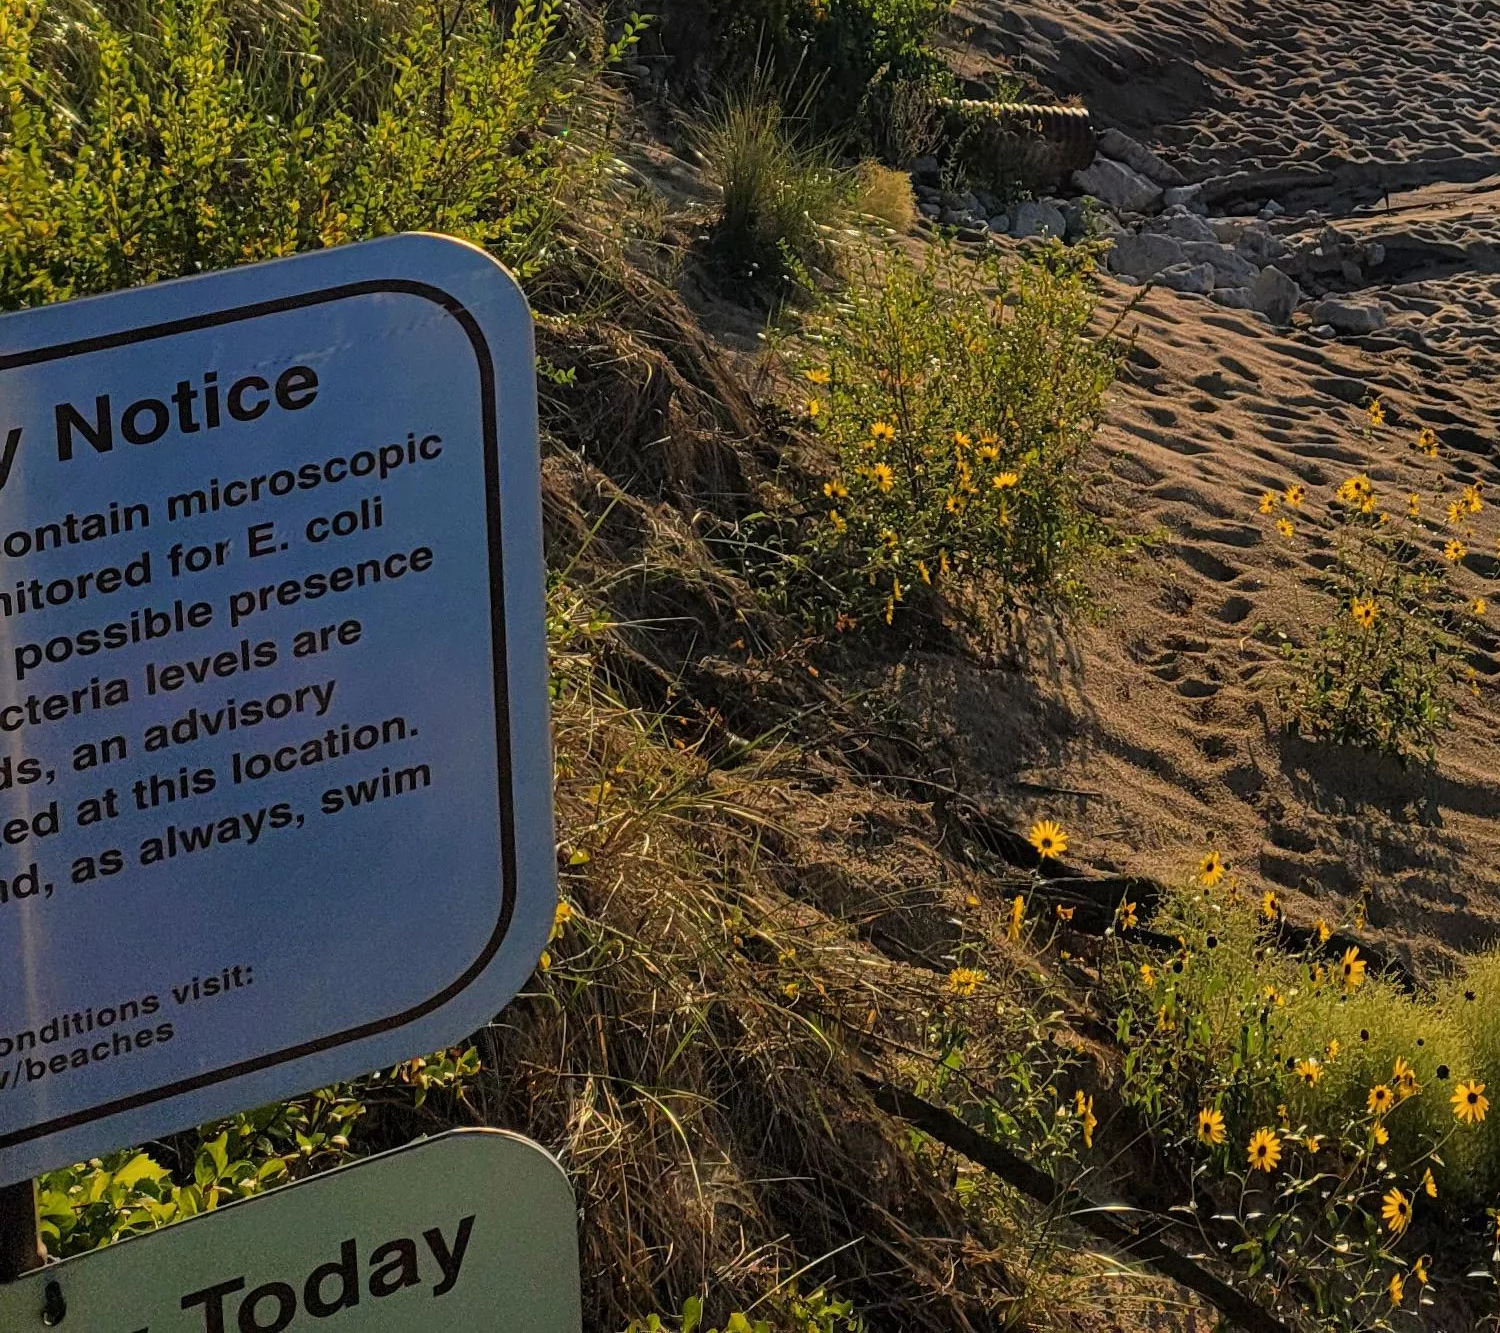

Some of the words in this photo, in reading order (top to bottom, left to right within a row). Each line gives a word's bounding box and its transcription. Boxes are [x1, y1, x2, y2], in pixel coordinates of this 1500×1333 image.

[55, 366, 319, 461] Notice
[0, 502, 150, 559] ontain
[168, 433, 442, 521] microscopic
[168, 542, 230, 576] for
[248, 522, 289, 558] E.
[306, 496, 382, 543] coli
[15, 600, 213, 680] possible
[230, 547, 434, 627] presence
[0, 678, 129, 732] cteria
[147, 640, 278, 695] levels
[294, 620, 362, 658] are
[73, 736, 127, 771] an
[145, 681, 336, 752] advisory
[0, 802, 59, 845] ed
[77, 789, 119, 826] at
[133, 753, 216, 809] this
[233, 718, 418, 783] location.
[72, 850, 124, 884] as
[140, 809, 305, 866] always,
[321, 765, 431, 815] swim
[172, 966, 253, 1005] visit:
[181, 1214, 476, 1333] Today
